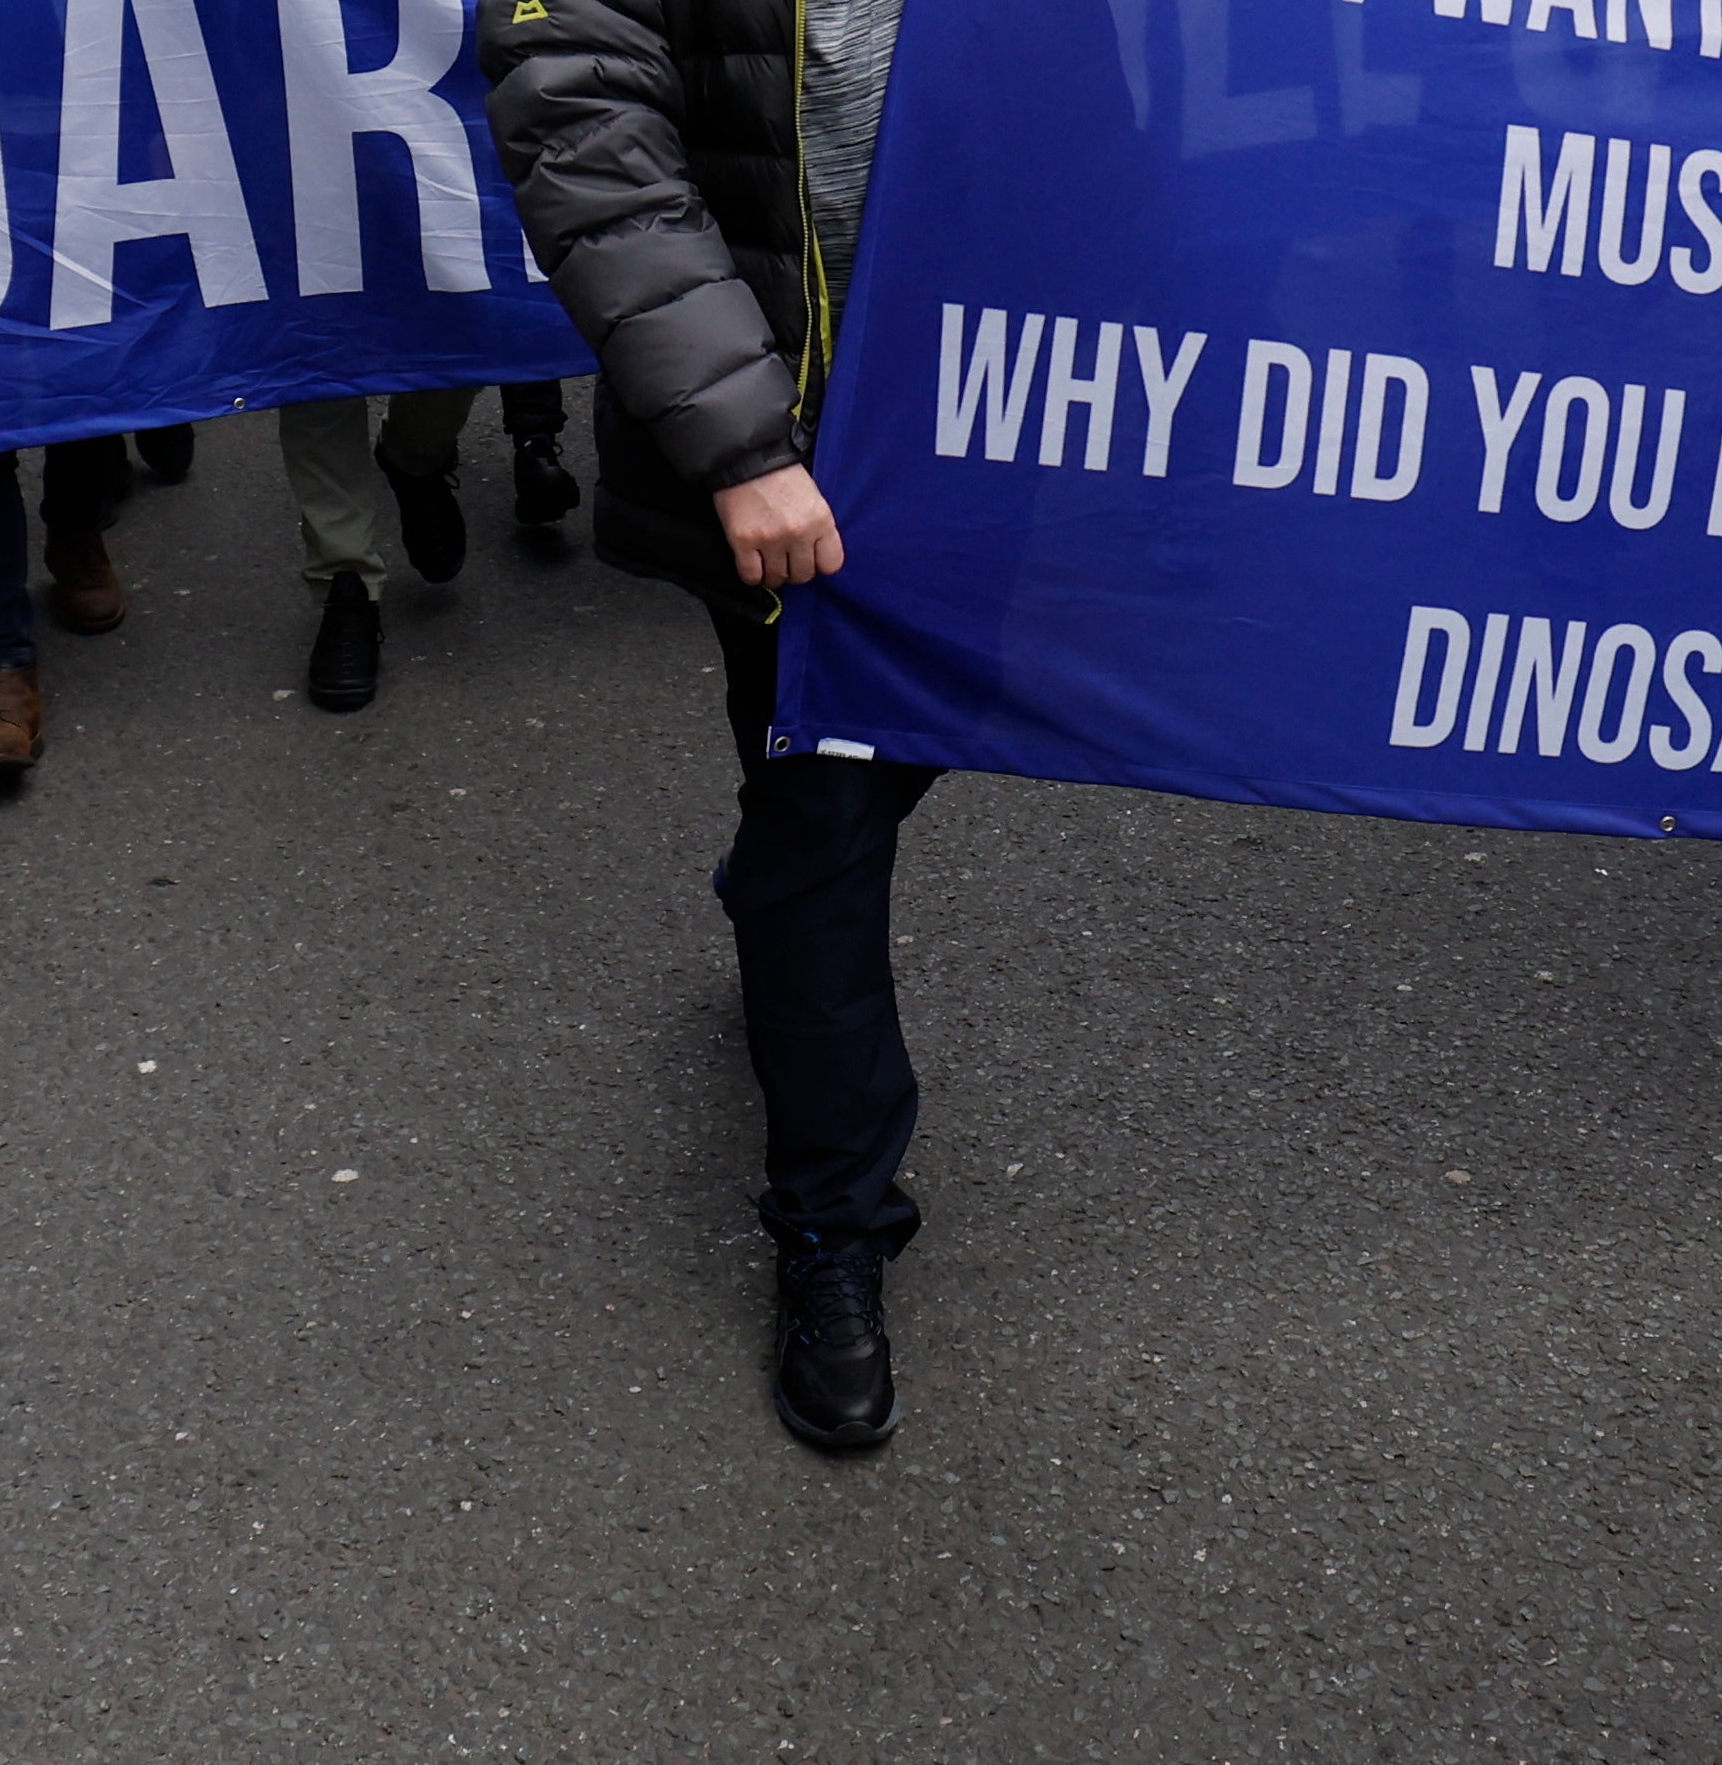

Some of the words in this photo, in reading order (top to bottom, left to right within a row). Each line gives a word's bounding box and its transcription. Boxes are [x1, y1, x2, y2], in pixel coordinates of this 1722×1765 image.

[935, 304, 1208, 478] WHY
[1233, 339, 1429, 502] DID
[1471, 365, 1686, 530] YOU
